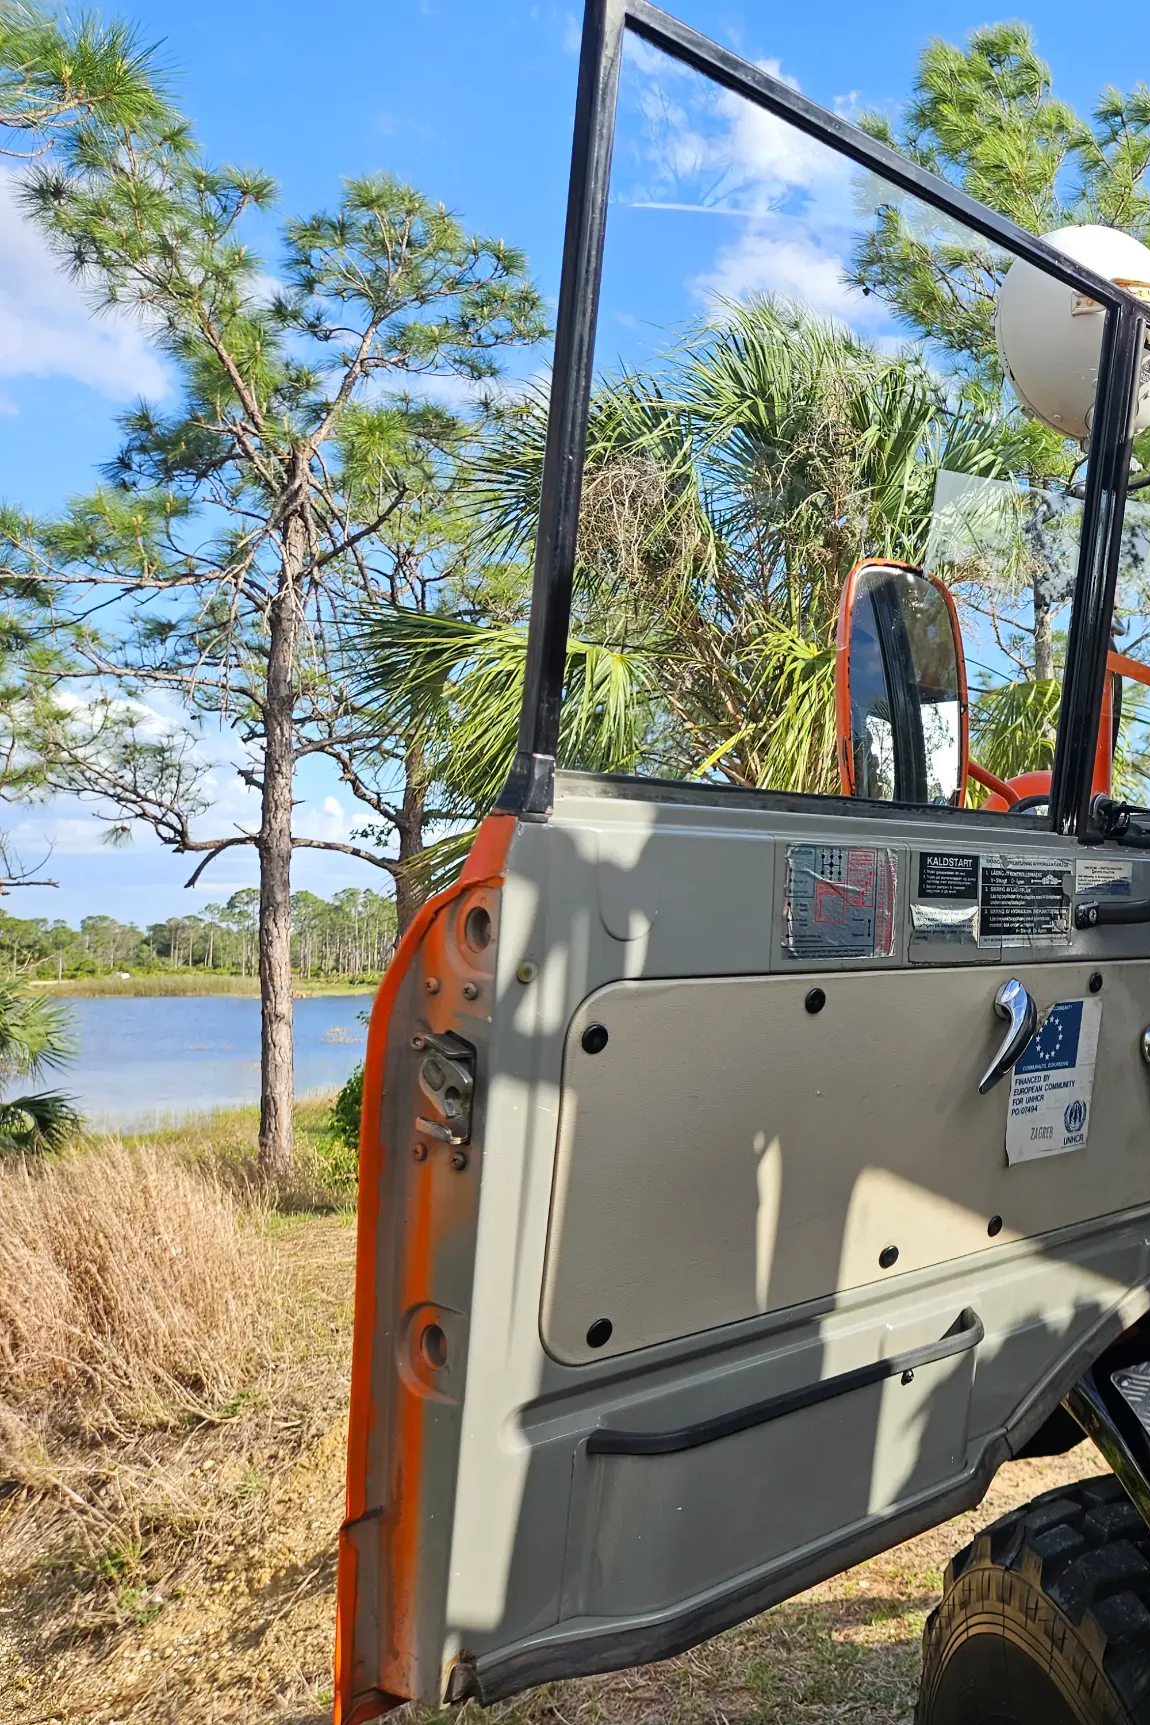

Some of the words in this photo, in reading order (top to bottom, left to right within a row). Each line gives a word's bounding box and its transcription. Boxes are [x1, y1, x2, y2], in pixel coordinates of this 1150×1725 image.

[926, 856, 972, 868] KALDSTART
[1015, 1076, 1041, 1086] FINANCED
[1014, 1085, 1042, 1096] EUROPEAN
[1045, 1080, 1075, 1091] COMMUNITY
[1012, 1098, 1024, 1106] FOR
[1026, 1094, 1044, 1104] UNHCR
[1030, 1126, 1054, 1140] ZAGREB
[1064, 1134, 1084, 1145] UNHCR
